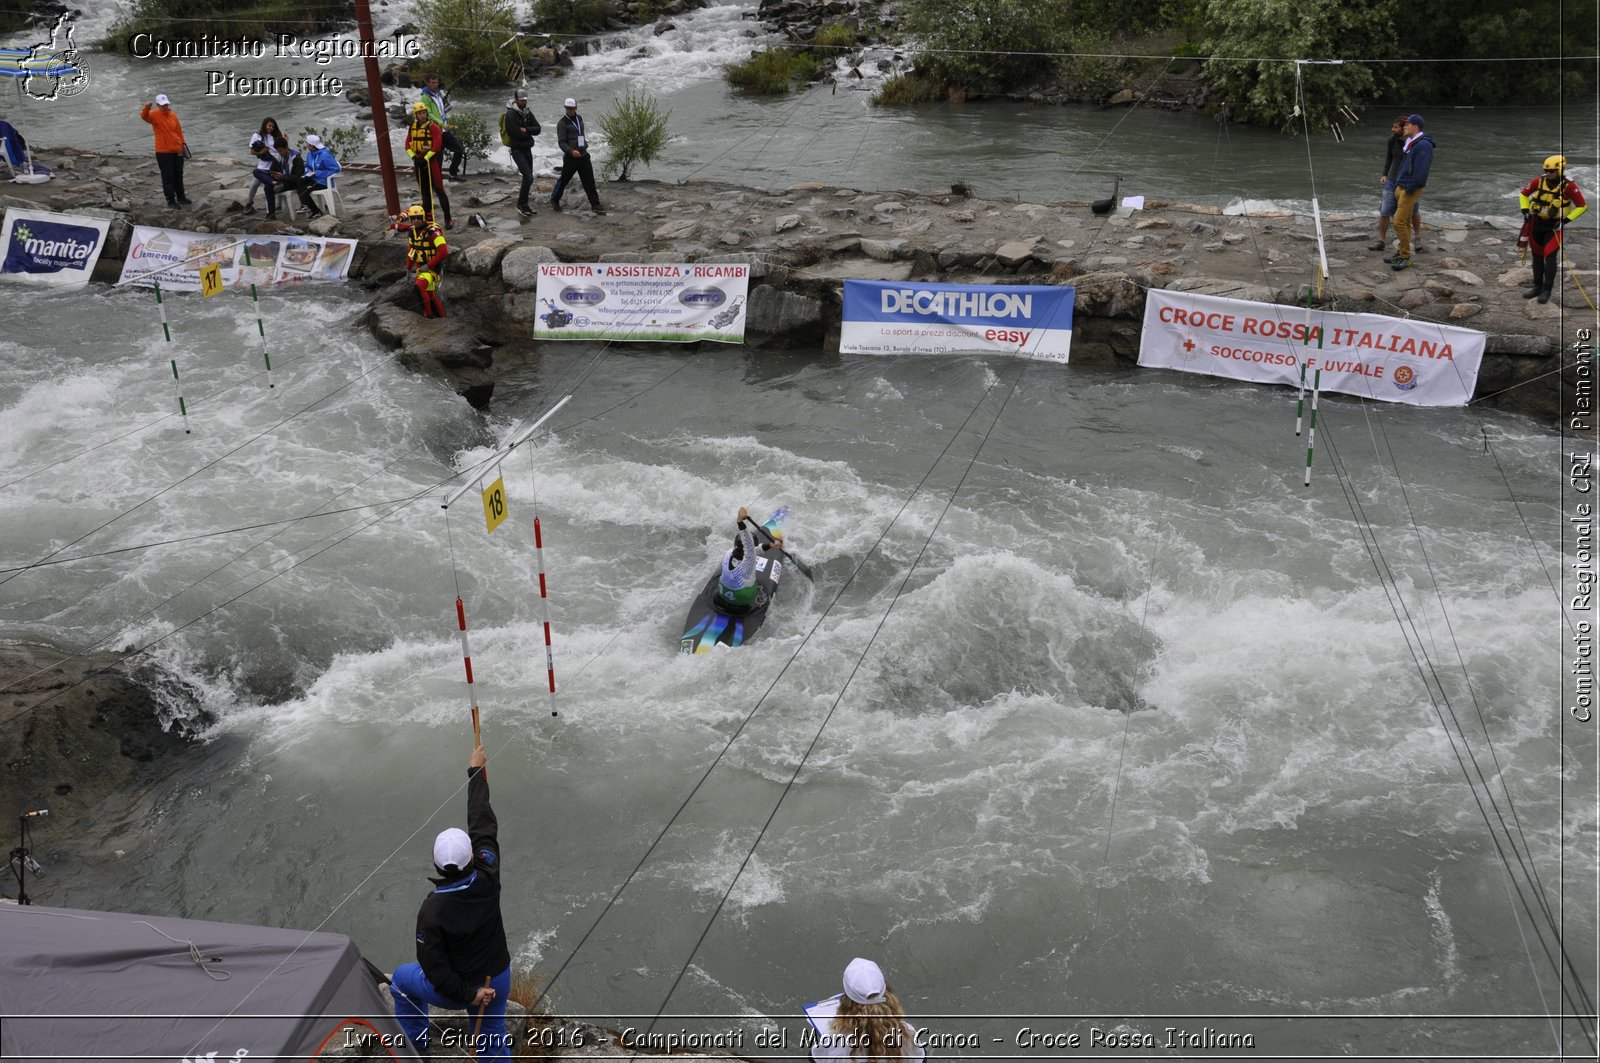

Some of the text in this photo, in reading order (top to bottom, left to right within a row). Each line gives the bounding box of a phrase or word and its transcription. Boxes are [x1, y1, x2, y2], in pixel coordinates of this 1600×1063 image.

[25, 238, 94, 259] manital
[205, 269, 217, 290] 17
[541, 266, 747, 278] VENDITA ASSISTENZA RICAMBI
[600, 280, 684, 288] www.gettomacchineagricole.com
[565, 292, 599, 301] GETTO
[684, 293, 720, 302] GETTO
[881, 289, 1032, 319] DECATHLON
[892, 328, 913, 337] sport
[921, 329, 944, 338] prezzi
[946, 330, 979, 338] discount
[985, 329, 1031, 347] easy
[1159, 306, 1454, 361] CROCE ROSSA ITALIANA
[1210, 345, 1297, 367] SOCCORSO
[488, 489, 503, 520] 18
